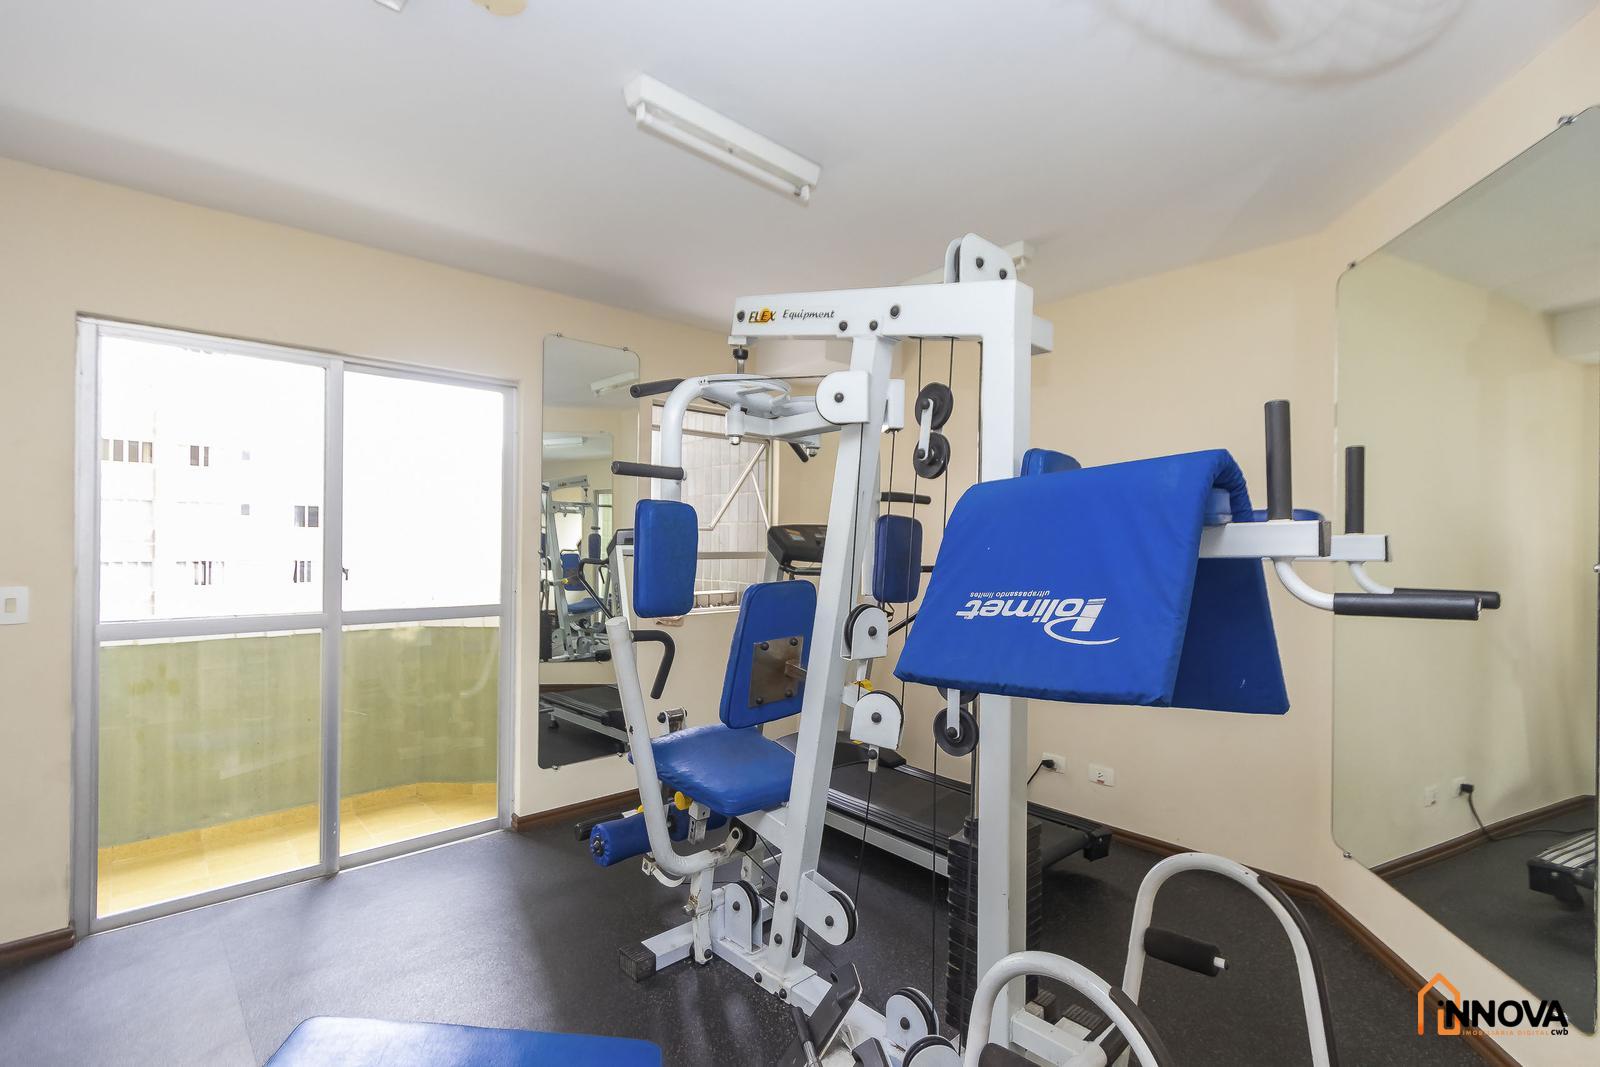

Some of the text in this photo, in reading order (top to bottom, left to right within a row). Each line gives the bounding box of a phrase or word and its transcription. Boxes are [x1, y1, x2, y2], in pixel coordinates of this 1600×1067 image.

[749, 309, 835, 323] FLEX Equipment
[996, 590, 1050, 598] ultrapassando
[956, 598, 1120, 645] Polimet
